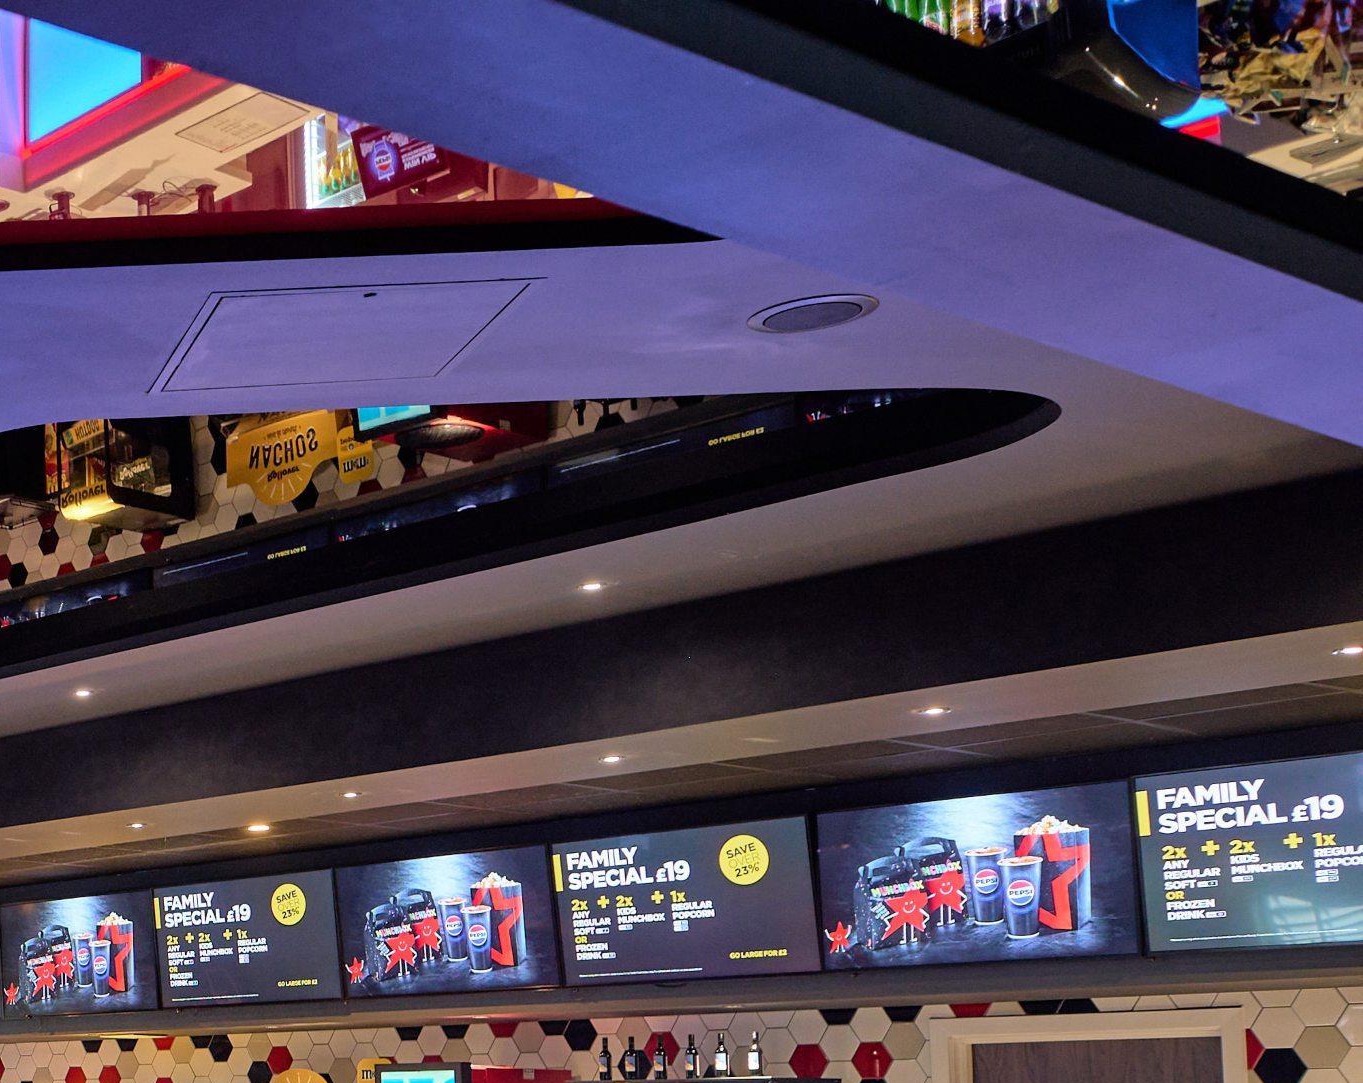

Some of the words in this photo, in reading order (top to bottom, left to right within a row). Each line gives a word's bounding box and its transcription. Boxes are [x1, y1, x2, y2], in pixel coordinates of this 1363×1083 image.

[1157, 779, 1264, 809] FAMILY
[1158, 803, 1288, 833] SPECIAL
[1291, 794, 1344, 823] £19
[726, 843, 756, 859] SAVE
[1162, 846, 1187, 860] 2x
[1229, 839, 1256, 854] 2x
[1312, 832, 1336, 846] 1x
[566, 847, 637, 871] FAMILY
[1163, 859, 1190, 870] ANY
[1230, 854, 1259, 864] KIDS
[735, 862, 760, 878] 23%
[1231, 861, 1304, 875] MUNCHBOX
[568, 869, 654, 891] SPECIAL
[656, 860, 691, 883] £19
[1163, 868, 1221, 881] REGULAR
[870, 879, 924, 898] MUNCHBOX
[1164, 879, 1196, 890] SOFT
[276, 890, 297, 903] SAVE
[571, 899, 588, 911] 2x
[616, 895, 633, 908] 2x
[669, 890, 685, 903] 1x
[1165, 891, 1185, 900] OR
[164, 892, 214, 911] FAMILY
[672, 901, 712, 912] REGULAR
[1166, 899, 1216, 910] FROZEN
[164, 909, 225, 928] SPECIAL
[227, 904, 252, 923] £19
[282, 908, 300, 919] 23%
[572, 911, 590, 920] ANY
[617, 907, 637, 916] KIDS
[672, 909, 715, 920] POPCORN
[1167, 910, 1206, 921] DRINK
[573, 917, 611, 927] REGULAR
[618, 913, 665, 924] MUNCHBOX
[575, 936, 587, 944] OR
[576, 943, 608, 952] FROZEN
[577, 952, 602, 961] DRINK
[730, 952, 740, 960] GO
[741, 951, 763, 959] LARGE
[764, 950, 778, 958] FOR
